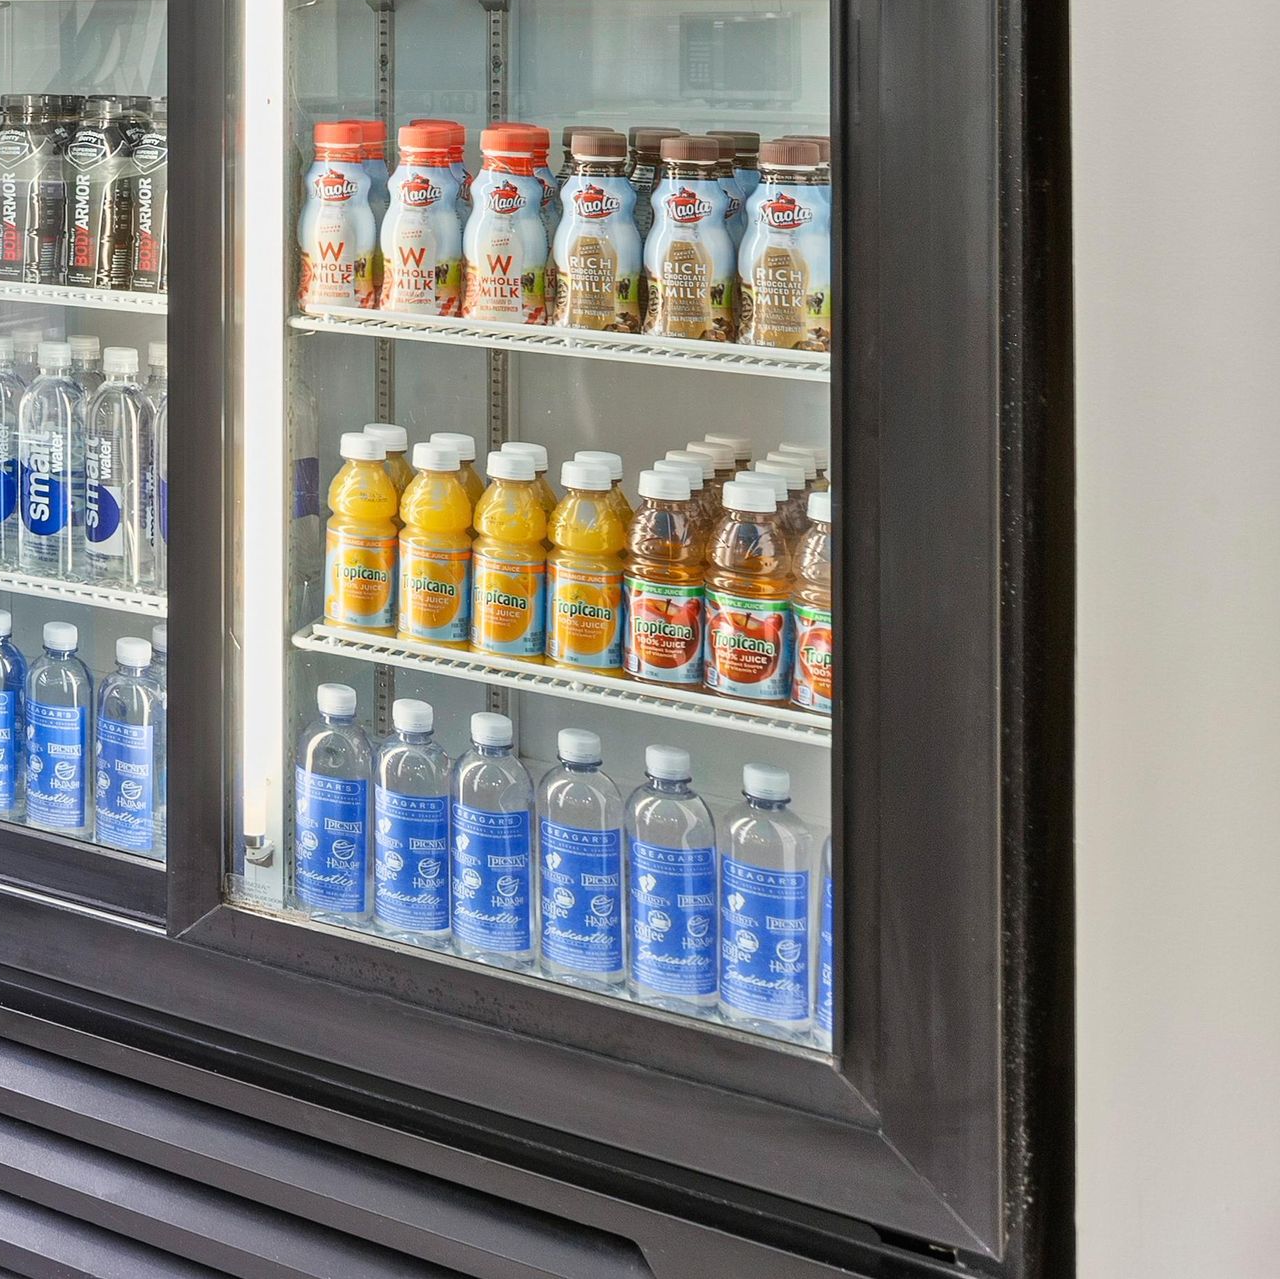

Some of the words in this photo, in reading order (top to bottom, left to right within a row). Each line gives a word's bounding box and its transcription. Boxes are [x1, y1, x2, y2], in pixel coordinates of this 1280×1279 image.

[664, 262, 706, 274] RICH
[756, 268, 801, 281] RICH
[481, 287, 519, 298] MILK
[665, 287, 706, 298] MILK
[757, 295, 801, 307] MILK
[0, 424, 10, 467] water
[51, 432, 64, 472] water
[99, 438, 112, 479] water
[30, 430, 51, 522] smart
[86, 437, 99, 528] smart
[335, 563, 387, 582] Tropicana
[403, 574, 455, 596] Tropicana
[474, 587, 526, 610] Tropicana
[555, 598, 611, 621] Tropicana
[633, 618, 692, 640] Tropicana
[661, 640, 686, 649] JUICE
[713, 631, 774, 655] Tropicana
[741, 655, 767, 664] JUICE
[547, 827, 609, 843] SEAGAR'S
[640, 848, 705, 862] SEAGAR'S
